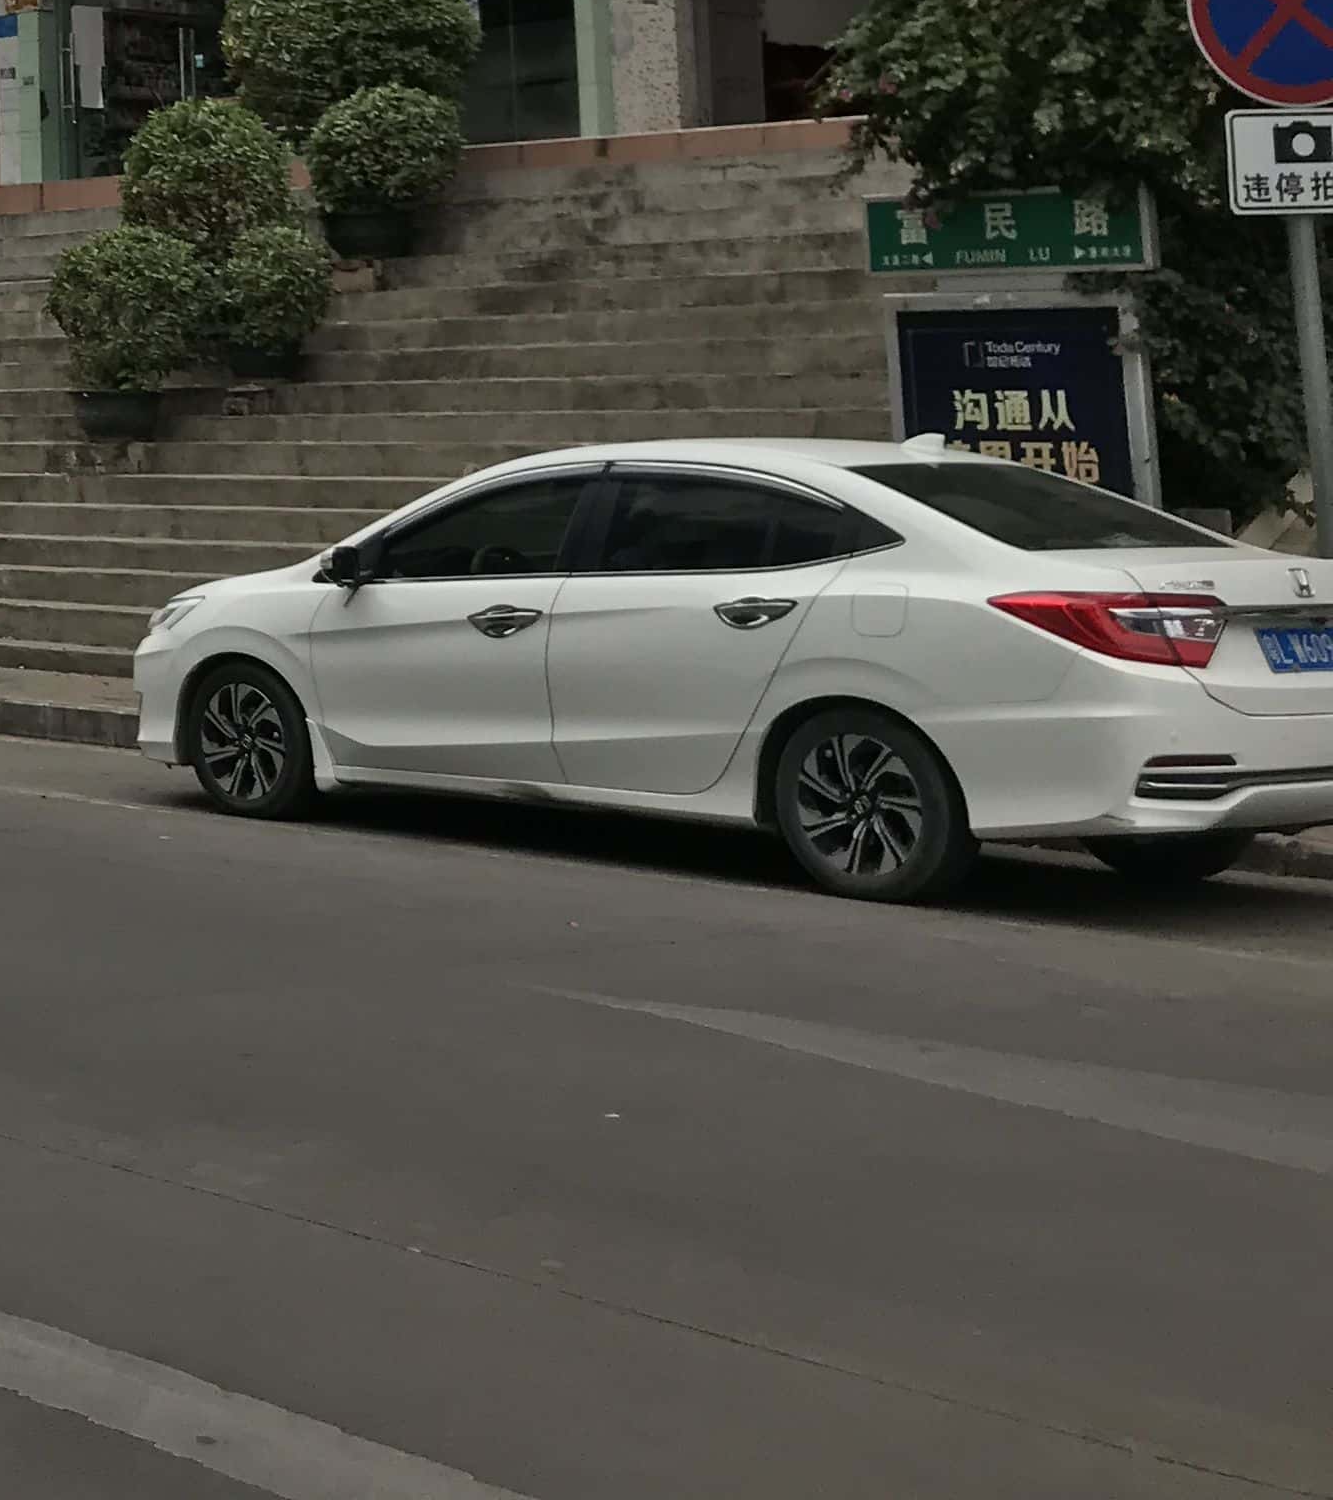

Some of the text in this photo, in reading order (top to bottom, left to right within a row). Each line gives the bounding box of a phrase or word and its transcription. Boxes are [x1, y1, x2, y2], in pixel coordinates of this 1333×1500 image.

[895, 199, 1110, 246] 富民路
[955, 247, 1051, 265] FUMIN LU
[952, 389, 1076, 431] 沟通从
[946, 440, 1101, 484] 开始
